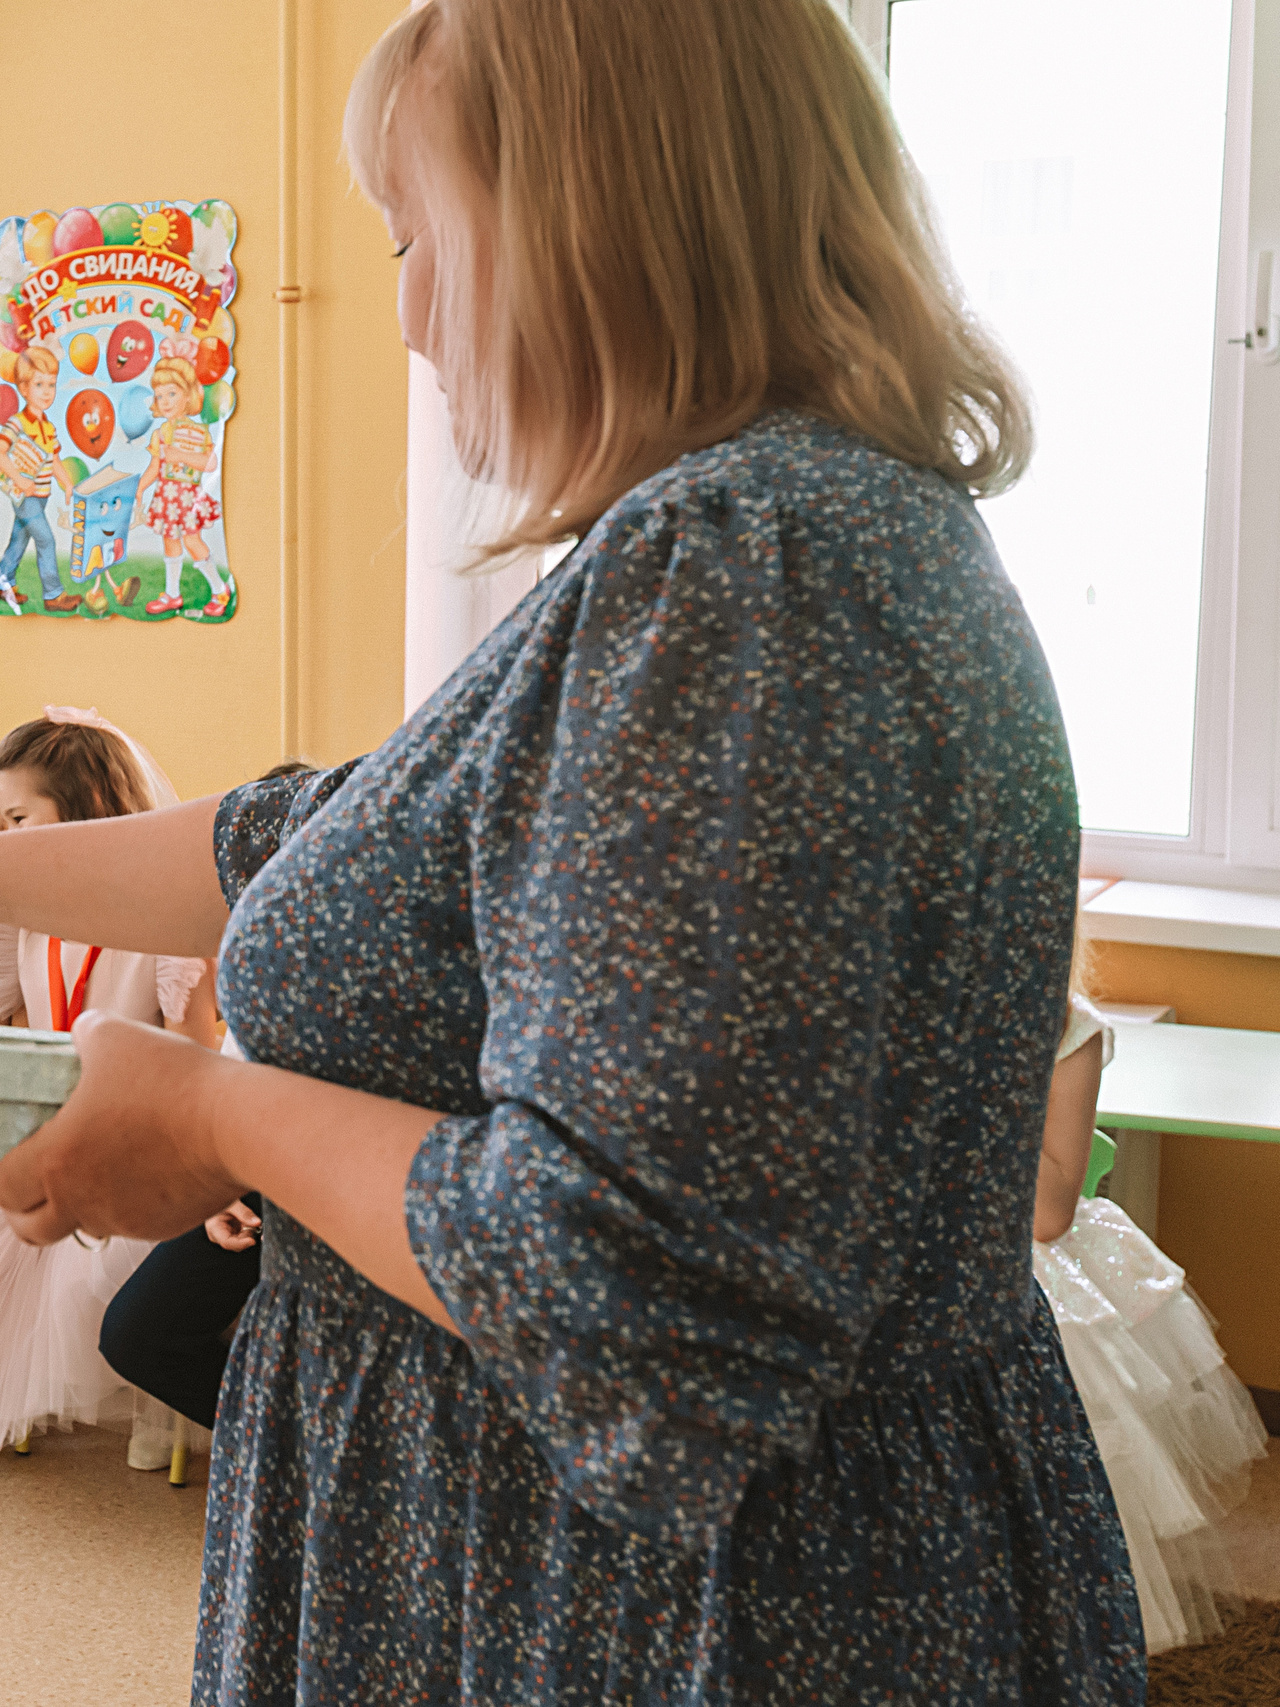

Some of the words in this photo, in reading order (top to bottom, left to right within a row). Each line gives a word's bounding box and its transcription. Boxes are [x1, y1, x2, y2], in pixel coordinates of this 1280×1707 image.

[23, 269, 60, 307] ДО
[69, 253, 200, 299] СВИДАНИЯ,
[37, 291, 134, 340] ДЕТСКИЙ
[140, 298, 191, 333] САД!
[70, 500, 86, 578] БУКВАРЬ
